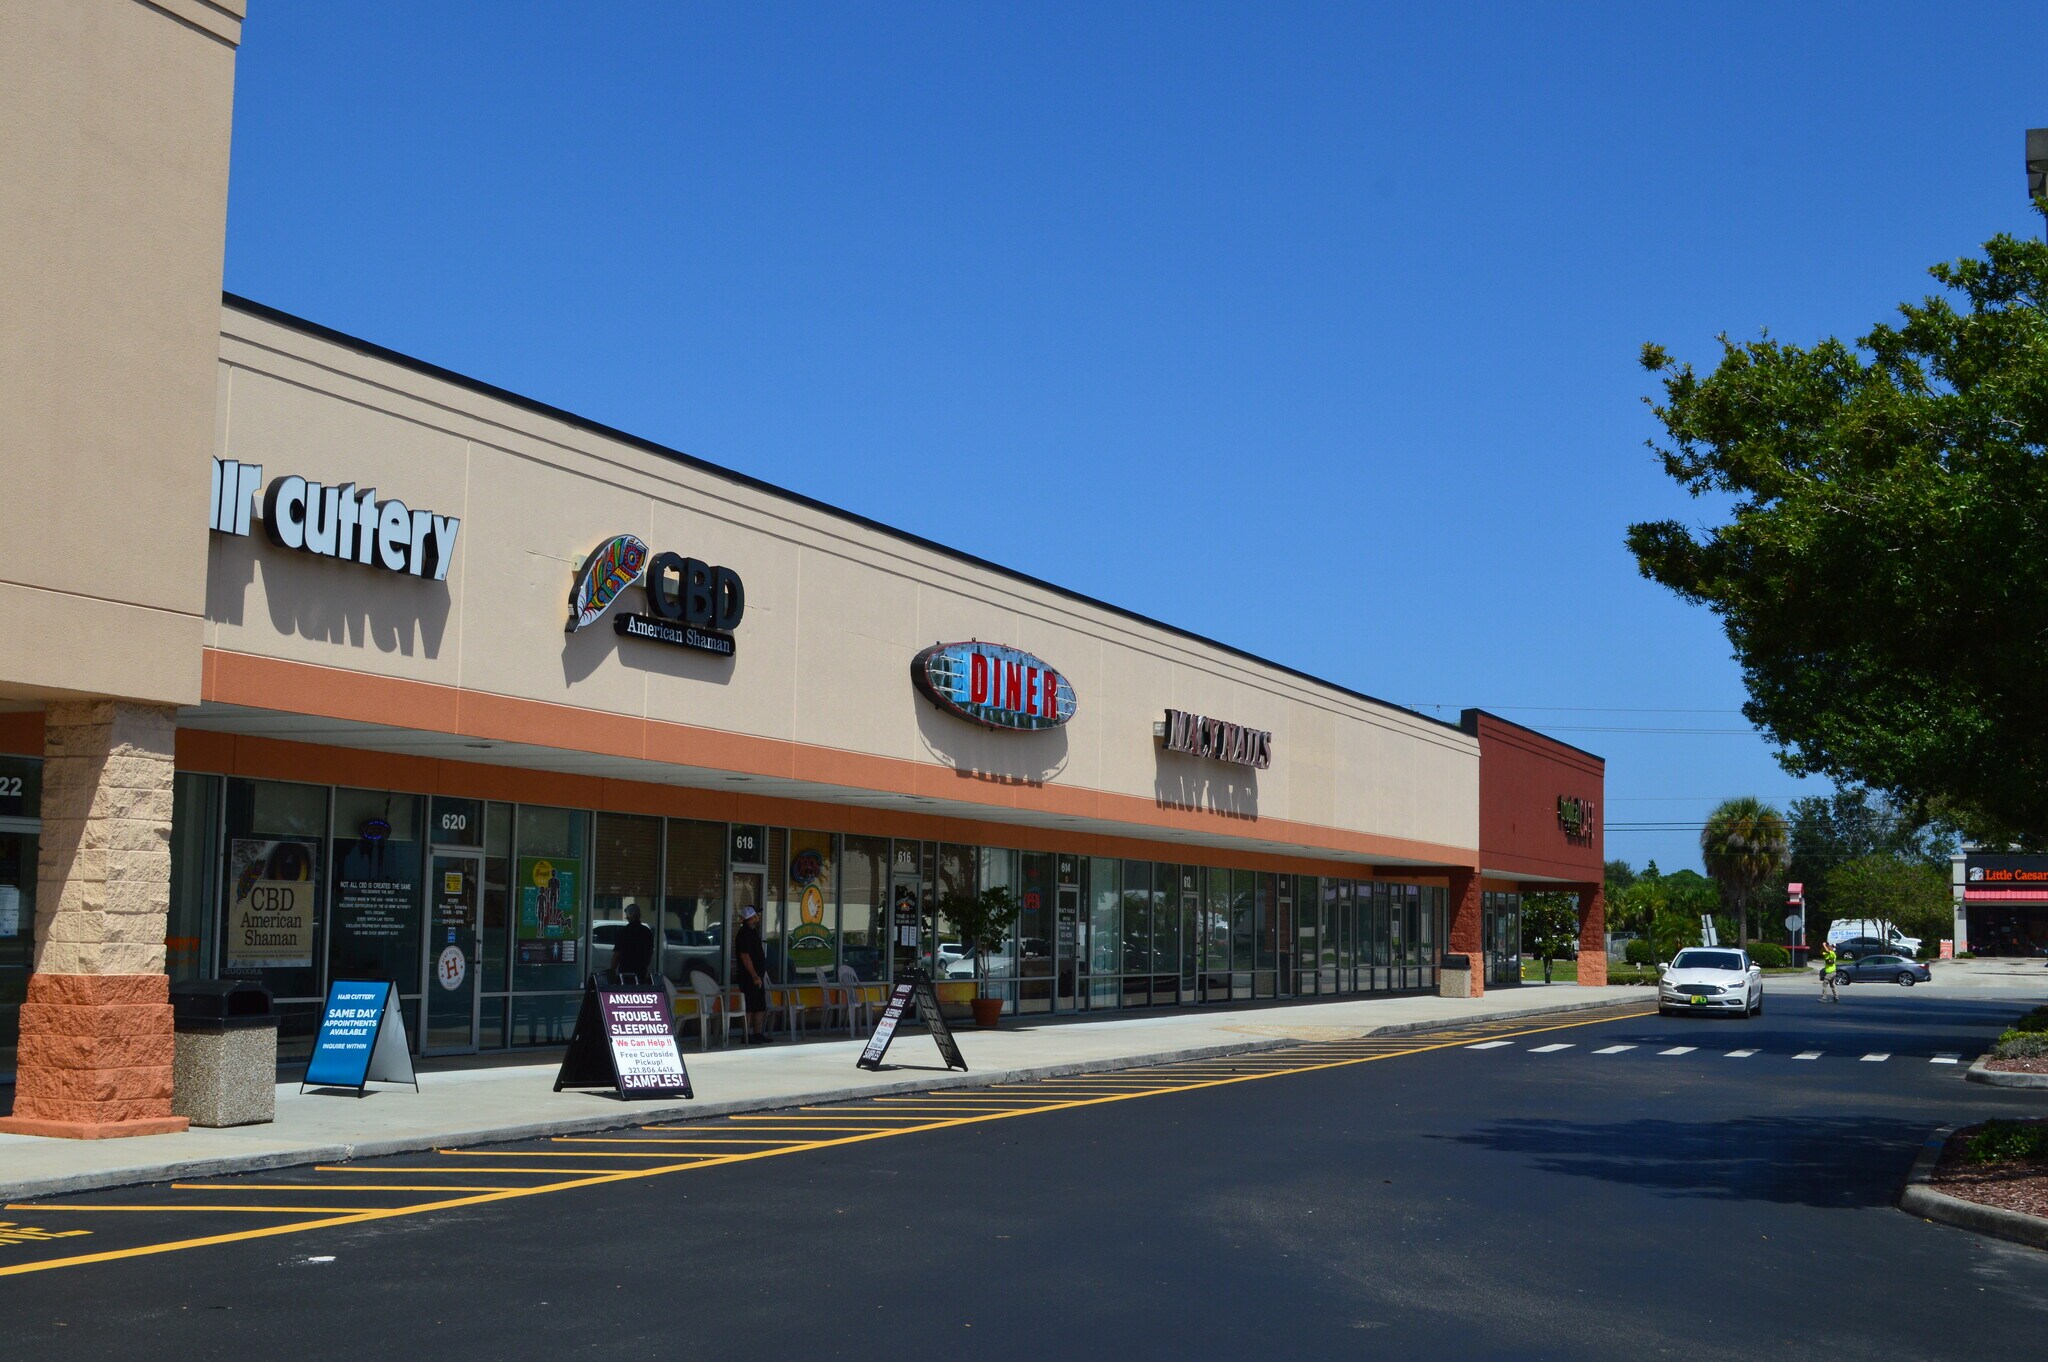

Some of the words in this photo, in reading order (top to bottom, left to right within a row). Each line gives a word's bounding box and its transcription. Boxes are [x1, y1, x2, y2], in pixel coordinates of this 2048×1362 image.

[647, 551, 744, 630] CBD
[626, 615, 683, 645] American
[685, 629, 731, 653] Shaman
[970, 652, 1058, 721] DINER
[1219, 721, 1271, 770] NAILS
[442, 814, 466, 831] 620
[736, 836, 754, 850] 618
[898, 851, 912, 863] 616
[1061, 863, 1072, 873] 614
[1985, 869, 2012, 881] Little
[2014, 870, 2048, 881] Caesar
[373, 882, 391, 890] CREATED
[251, 887, 294, 911] CBD
[240, 912, 303, 928] American
[244, 930, 298, 946] Shaman
[446, 957, 459, 980] H
[609, 994, 658, 1004] ANXIOUS?
[328, 1009, 356, 1018] SAME
[356, 1009, 377, 1018] DAY
[611, 1011, 662, 1022] TROUBLE
[329, 1028, 368, 1036] AVAILABLE
[611, 1024, 668, 1034] SLEEPING?
[648, 1039, 665, 1048] Help
[640, 1052, 674, 1060] Curbside
[635, 1060, 663, 1068] Pickup!
[624, 1075, 684, 1088] SAMPLES!
